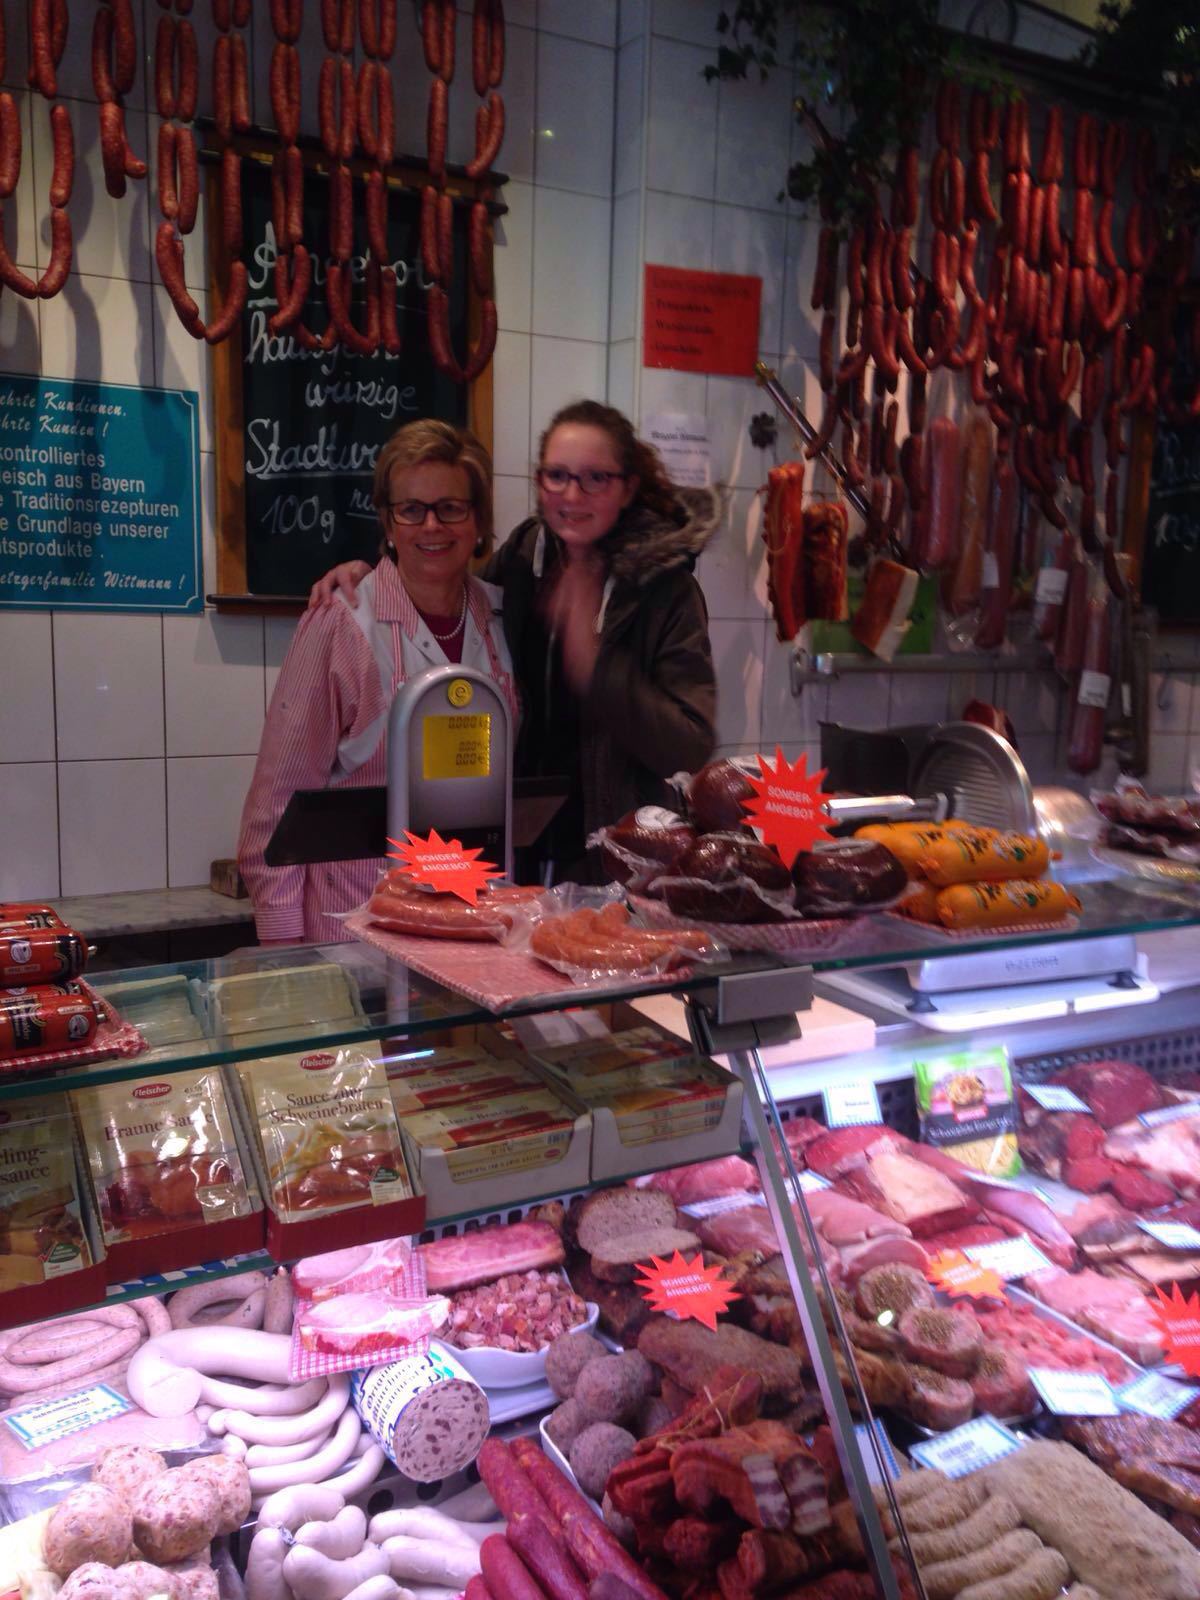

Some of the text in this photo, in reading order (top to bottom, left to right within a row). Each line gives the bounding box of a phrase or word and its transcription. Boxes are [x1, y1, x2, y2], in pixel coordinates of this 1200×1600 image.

[0, 412, 31, 431] hrte
[39, 415, 94, 436] Kunden
[0, 465, 145, 494] eisch aus Bayern
[13, 490, 179, 519] Traditionsrezepturen
[17, 513, 102, 539] Grundlage
[110, 521, 168, 540] unserer
[0, 537, 93, 559] tsprodukte
[104, 571, 171, 590] Wittmann
[422, 861, 472, 872] ANGEBOT
[134, 1084, 172, 1098] Fleischer
[286, 1091, 330, 1107] Sauce
[170, 1113, 214, 1127] Sae
[270, 1099, 384, 1124] Schweinebraten
[0, 1148, 49, 1167] ling-
